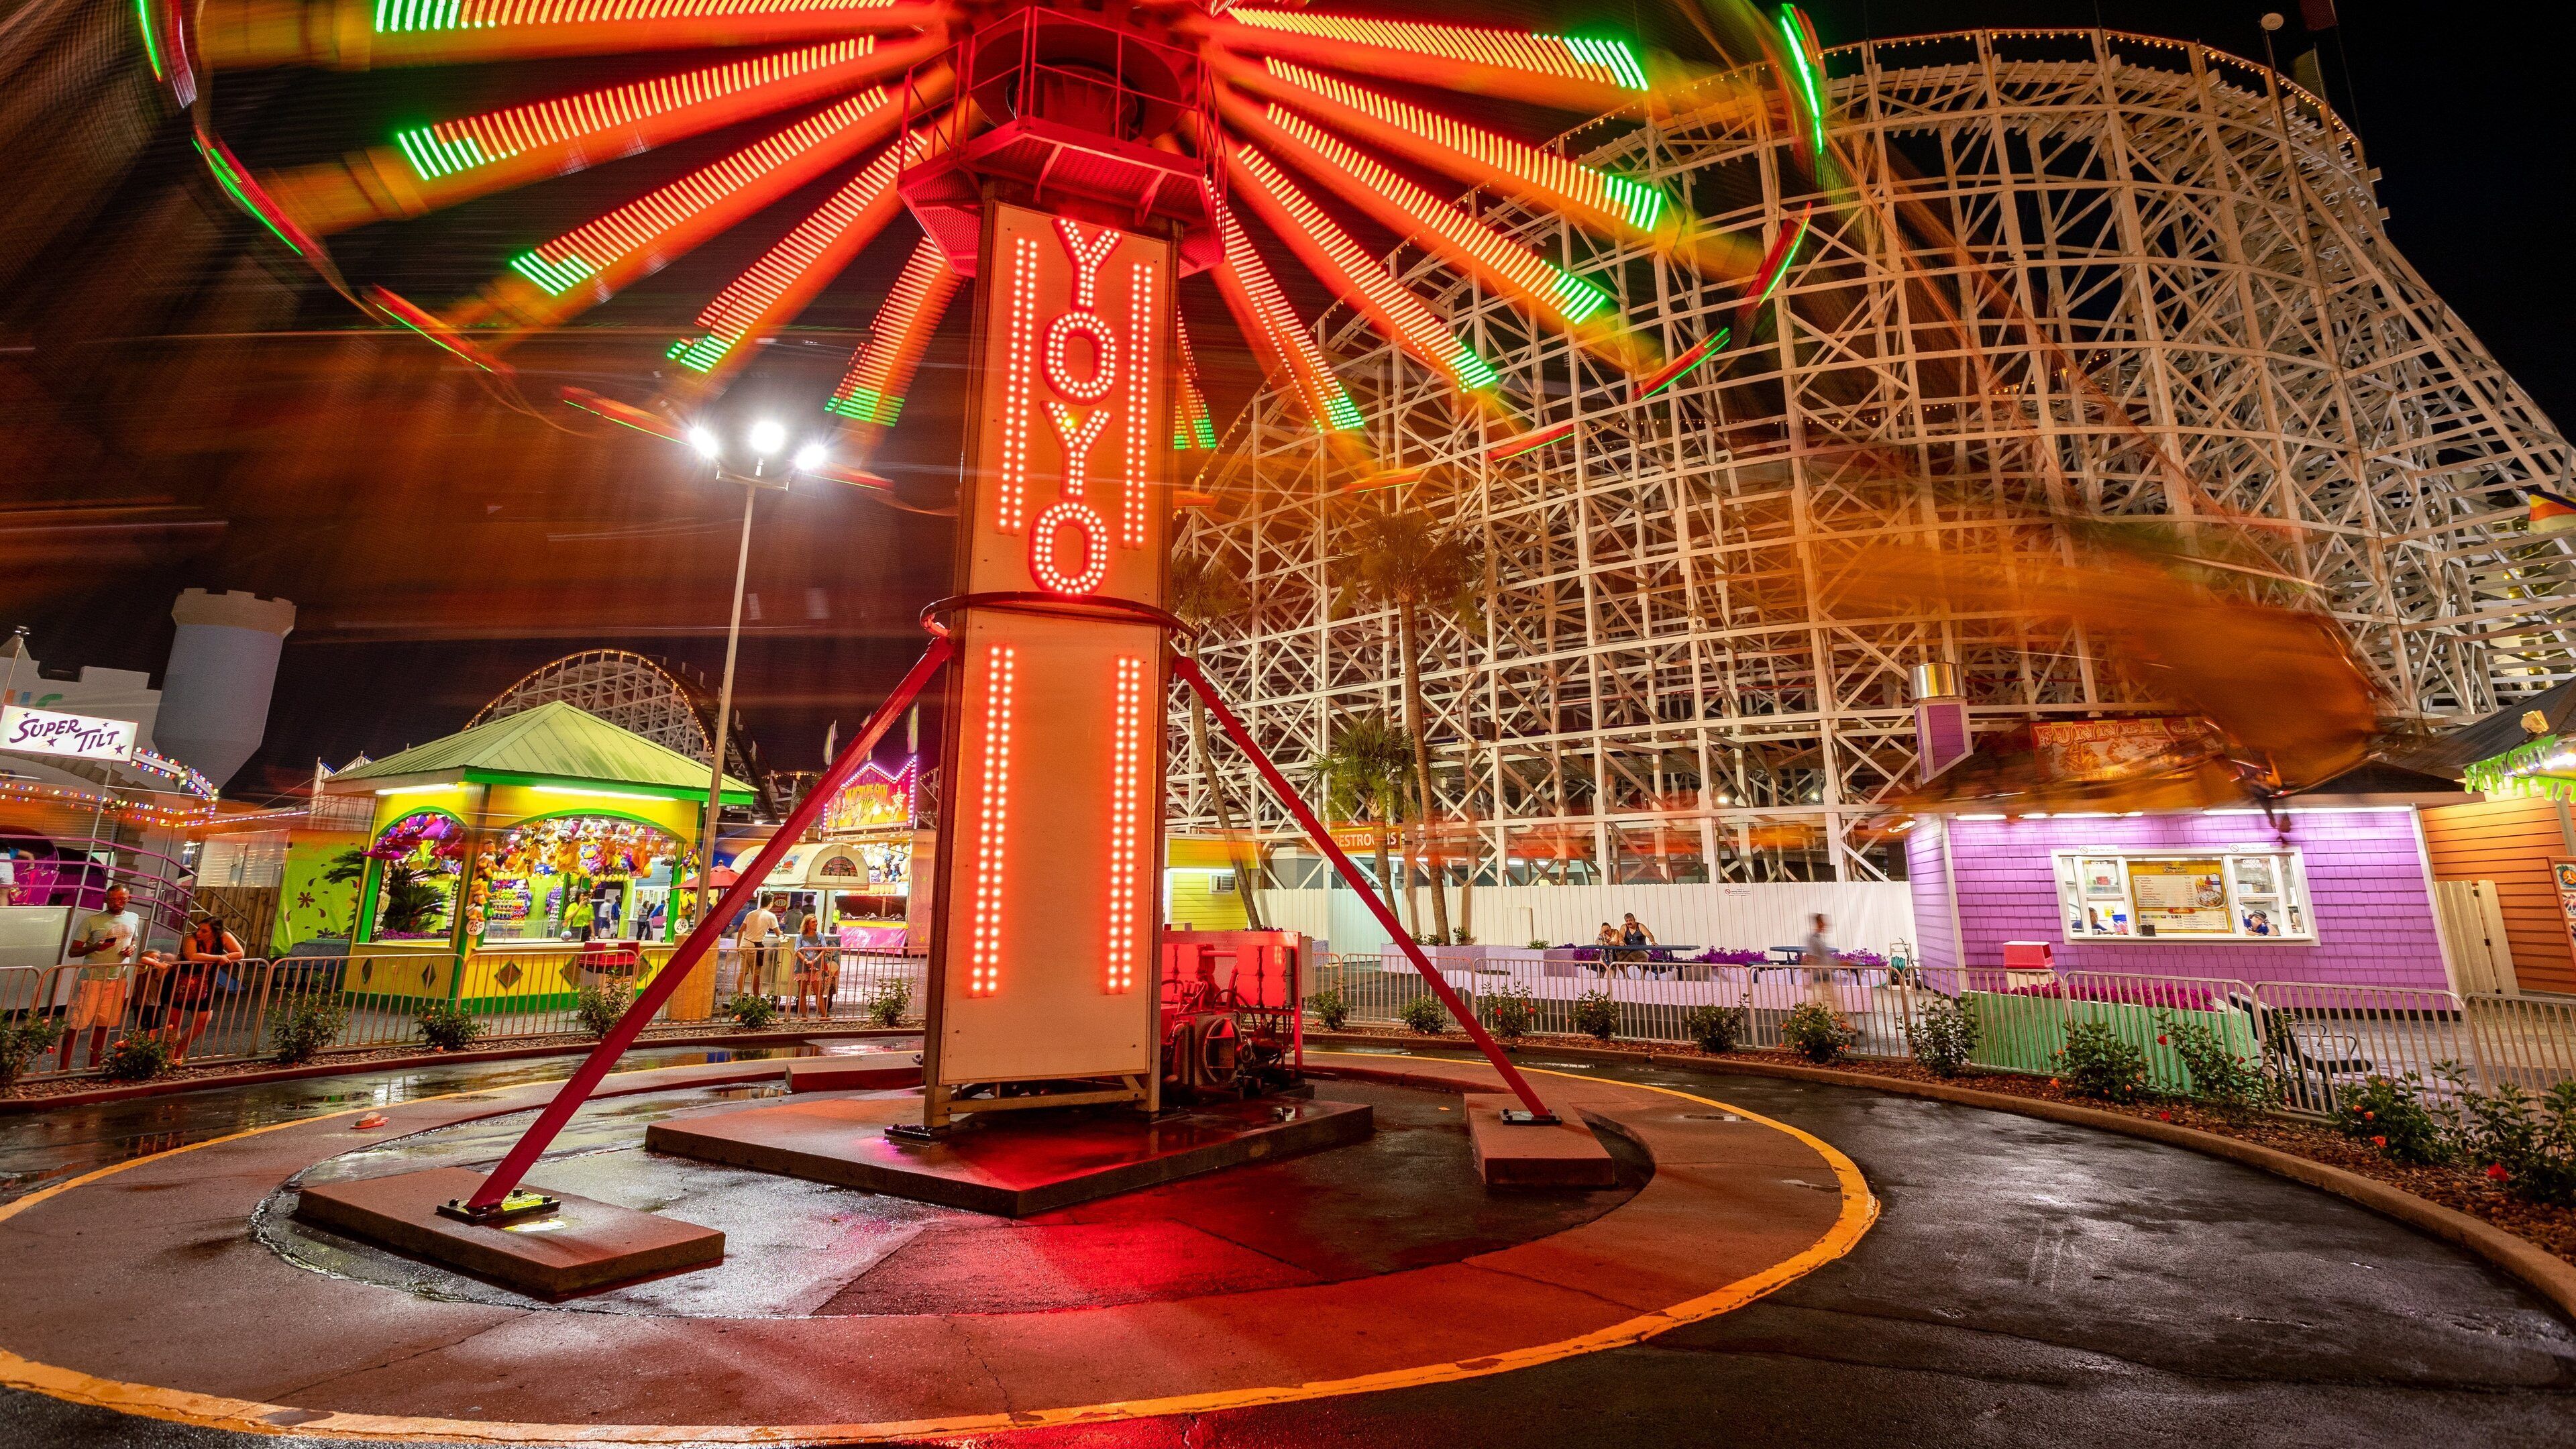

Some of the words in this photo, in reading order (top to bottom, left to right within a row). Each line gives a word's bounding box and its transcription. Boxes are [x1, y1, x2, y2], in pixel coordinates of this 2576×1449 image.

[9, 718, 82, 743] SUPER
[74, 729, 119, 752] TILT
[2034, 721, 2163, 747] FUNNEL
[469, 922, 483, 932] 25¢
[676, 922, 687, 930] 25¢
